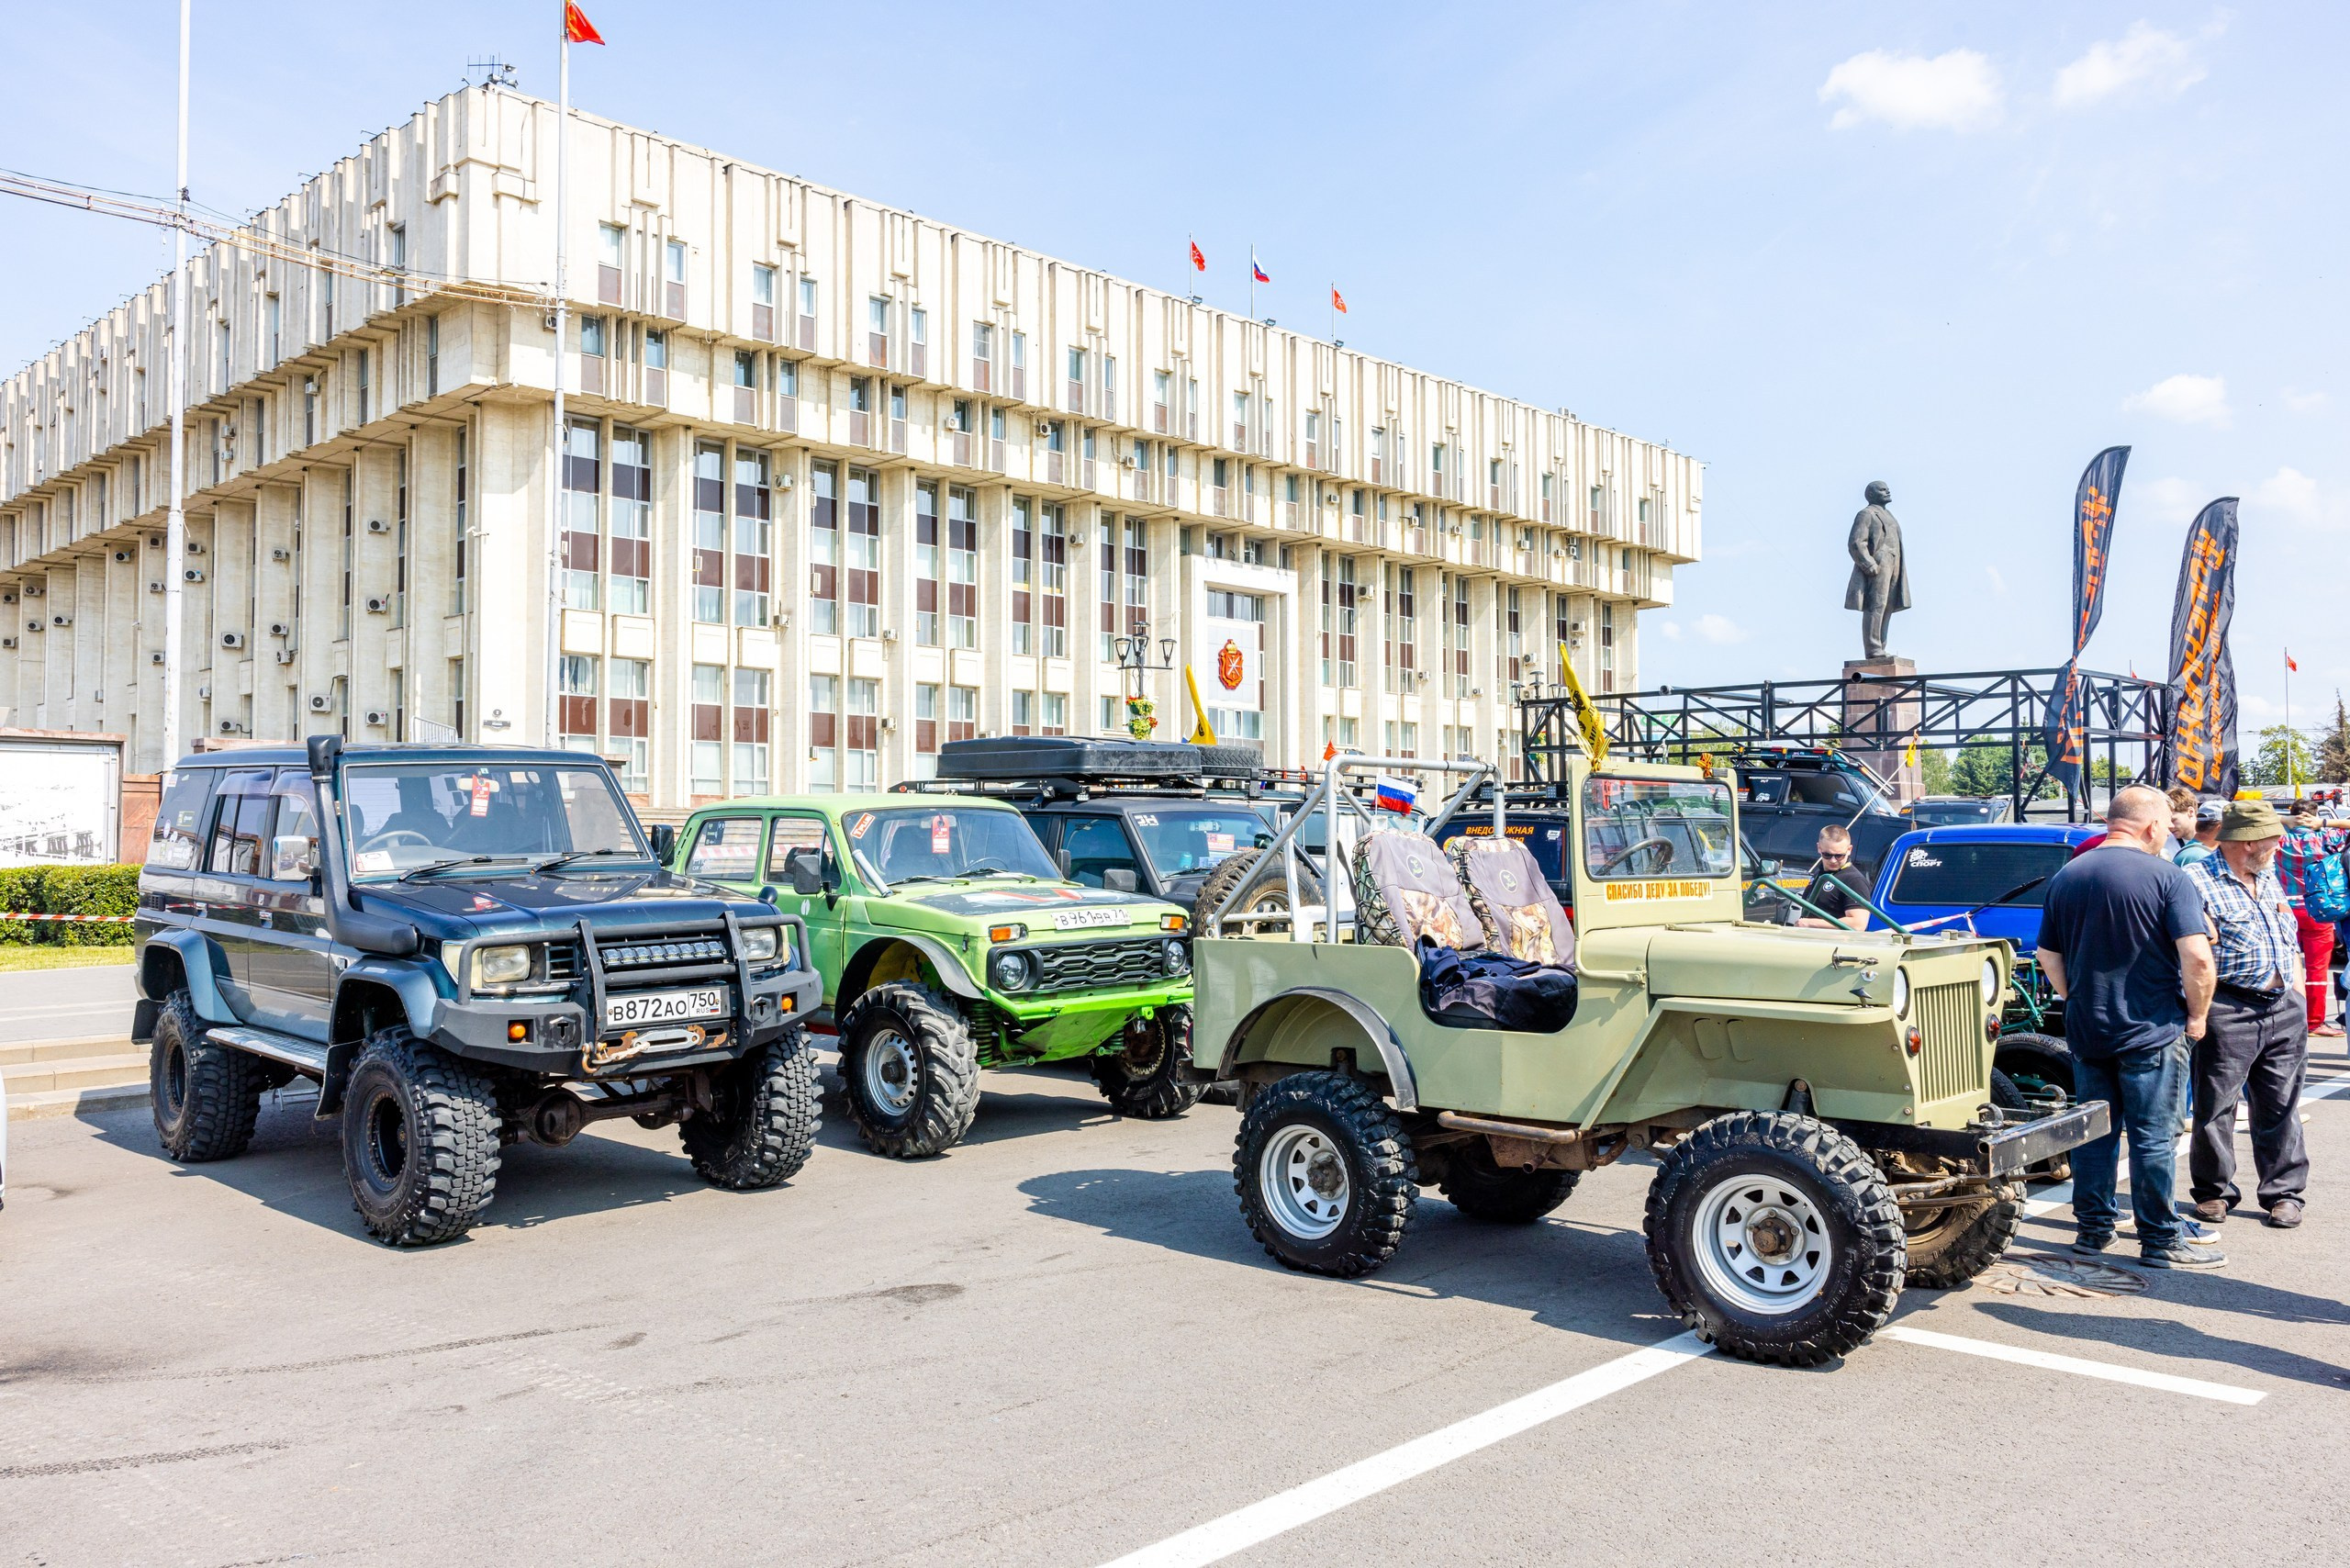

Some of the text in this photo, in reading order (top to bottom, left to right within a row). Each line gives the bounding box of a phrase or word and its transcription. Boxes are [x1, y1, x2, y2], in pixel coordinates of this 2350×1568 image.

[1465, 826, 1534, 835] ВНЕДОЖНАЯ
[1606, 881, 1711, 901] СПАСИБО ДЕДУ ЗА ПОБЕДУ!
[689, 991, 716, 1008] 750
